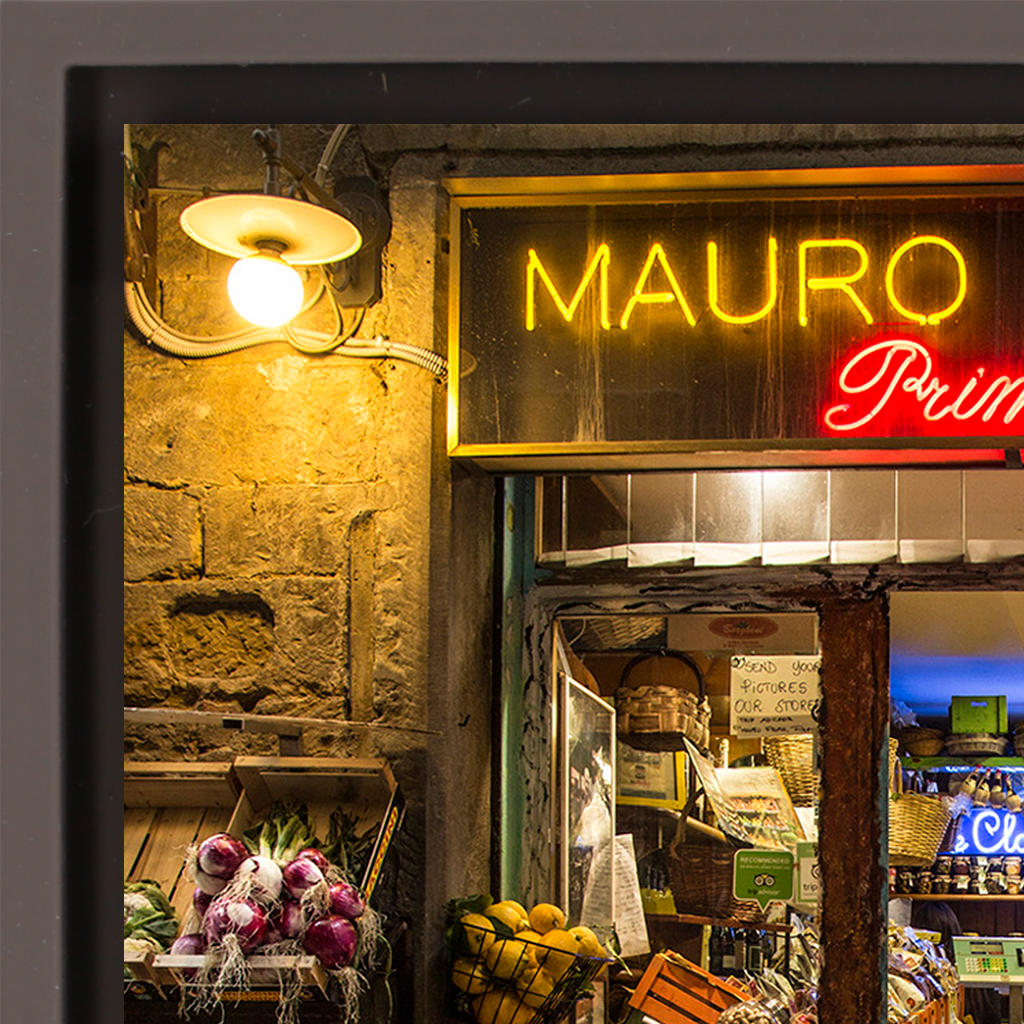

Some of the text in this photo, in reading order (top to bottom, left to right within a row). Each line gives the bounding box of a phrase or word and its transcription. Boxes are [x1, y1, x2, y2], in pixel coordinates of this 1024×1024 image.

[523, 235, 968, 330] MAURO
[744, 661, 778, 674] SEND
[734, 699, 762, 714] OUR
